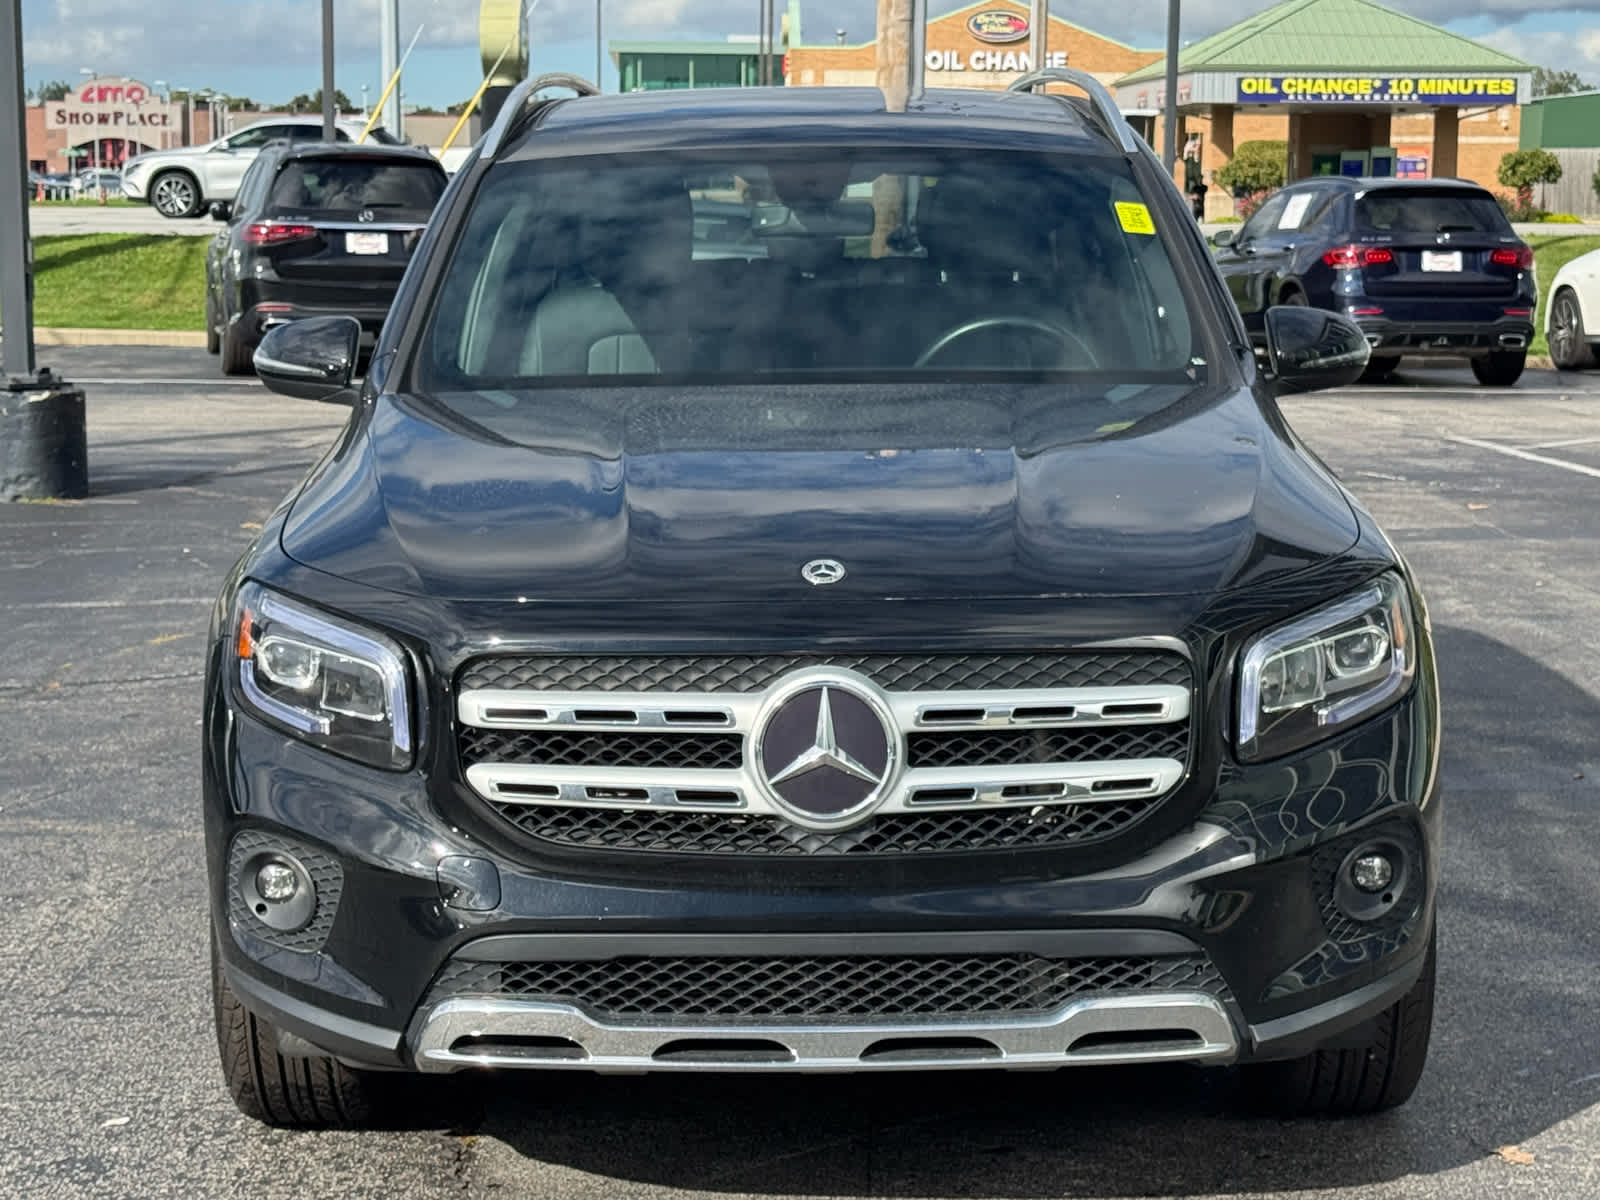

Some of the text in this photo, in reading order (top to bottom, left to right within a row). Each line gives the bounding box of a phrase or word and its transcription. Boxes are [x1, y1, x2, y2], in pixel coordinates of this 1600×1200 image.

[925, 50, 964, 71] OIL
[1241, 78, 1278, 94] OIL
[1388, 78, 1414, 95] 10
[1417, 78, 1516, 95] MINUTES
